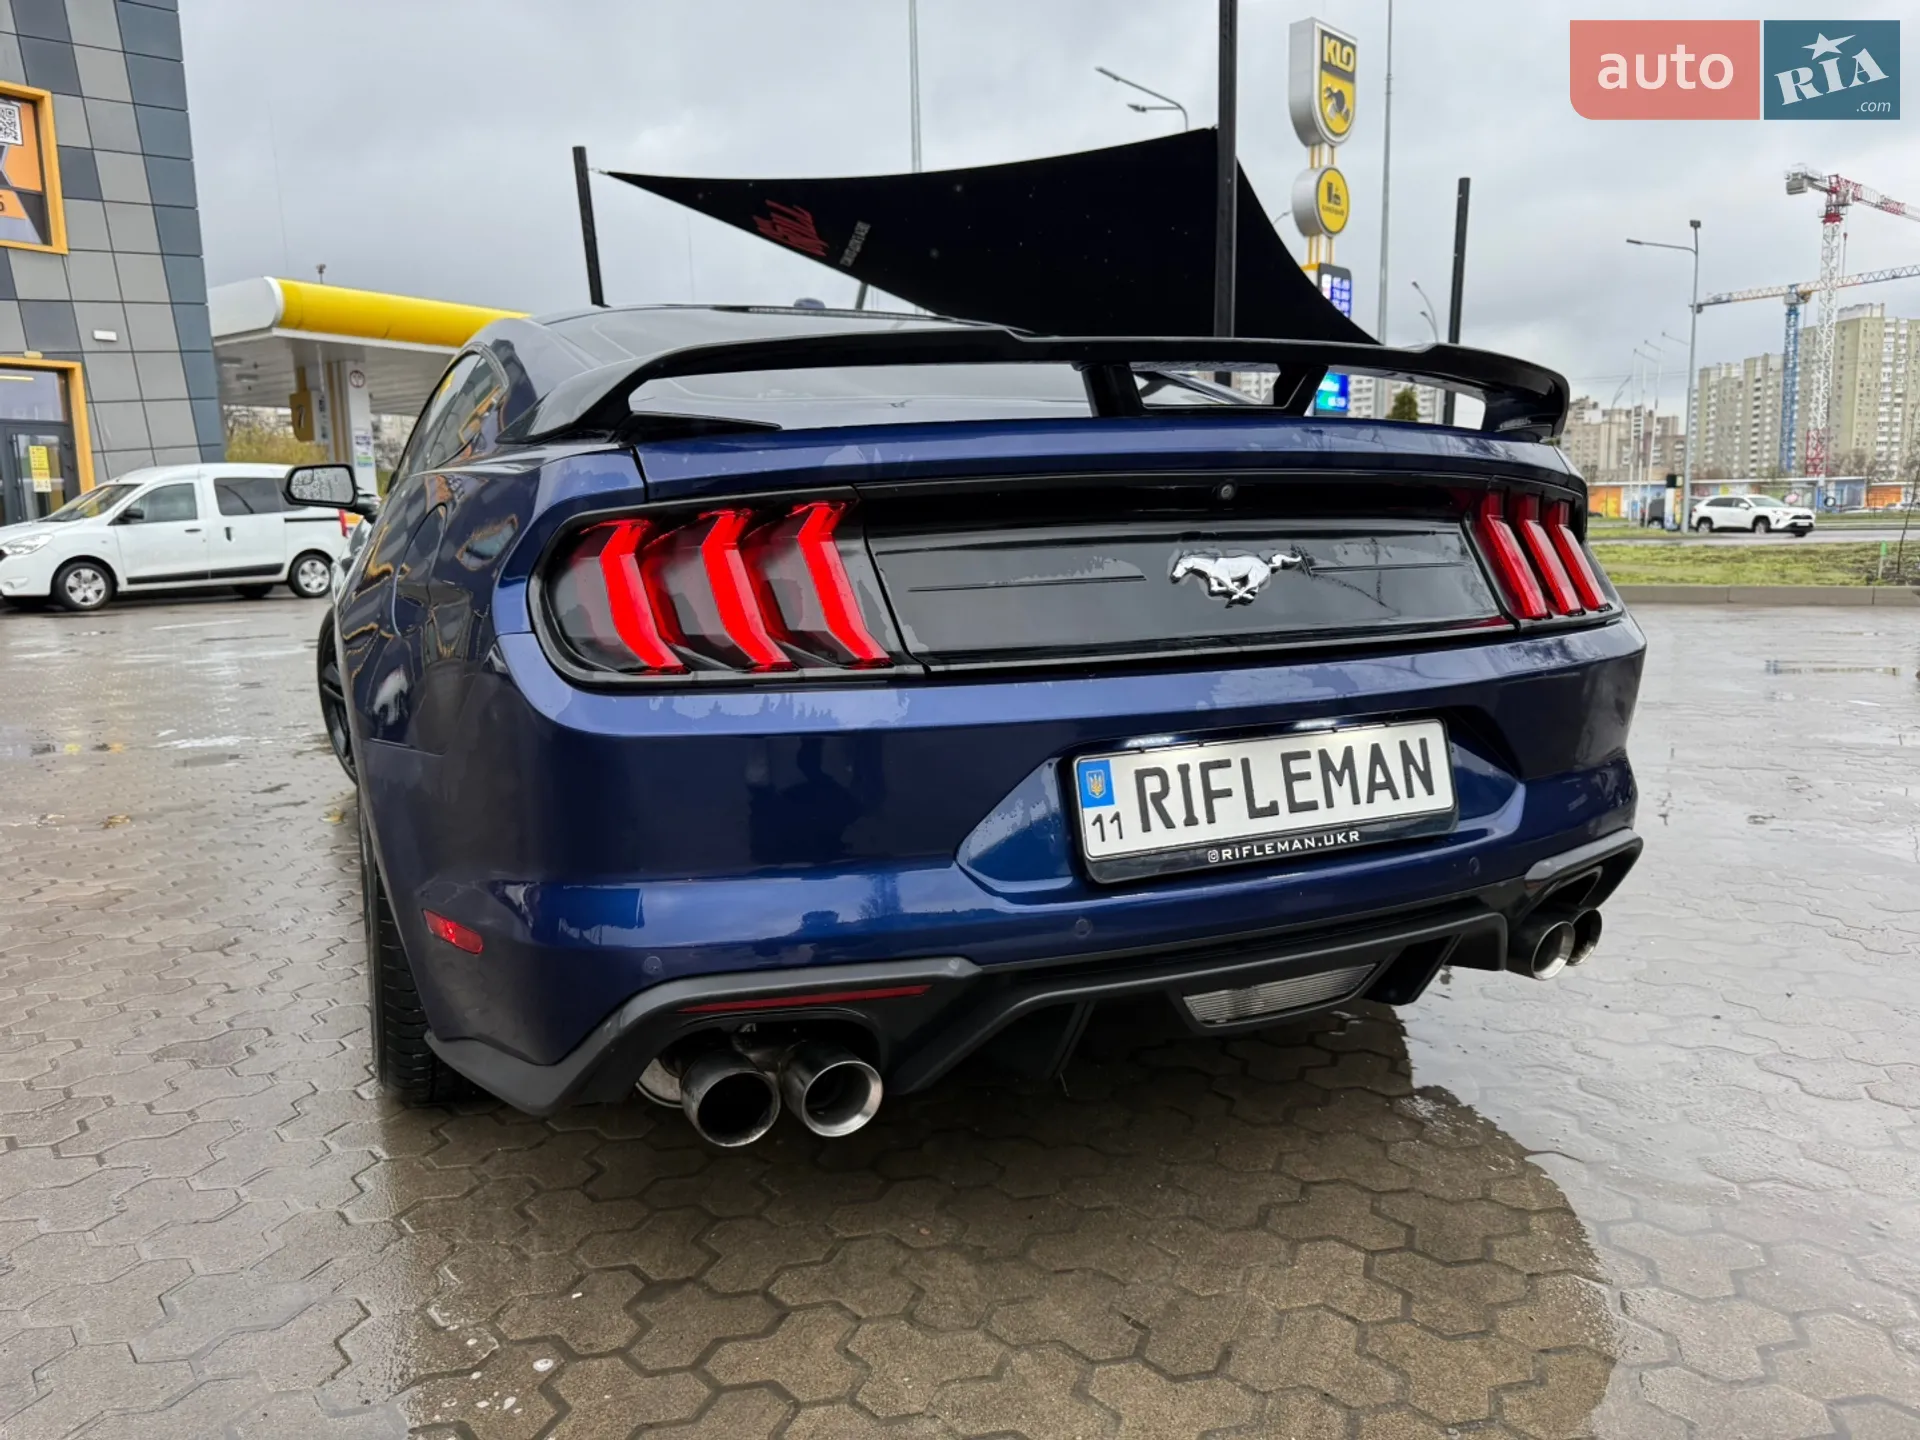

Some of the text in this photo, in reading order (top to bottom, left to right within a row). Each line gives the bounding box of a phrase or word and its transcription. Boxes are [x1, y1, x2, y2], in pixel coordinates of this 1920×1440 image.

[1323, 36, 1354, 72] KLO
[1092, 738, 1434, 842] 11 RIFLEMAN
